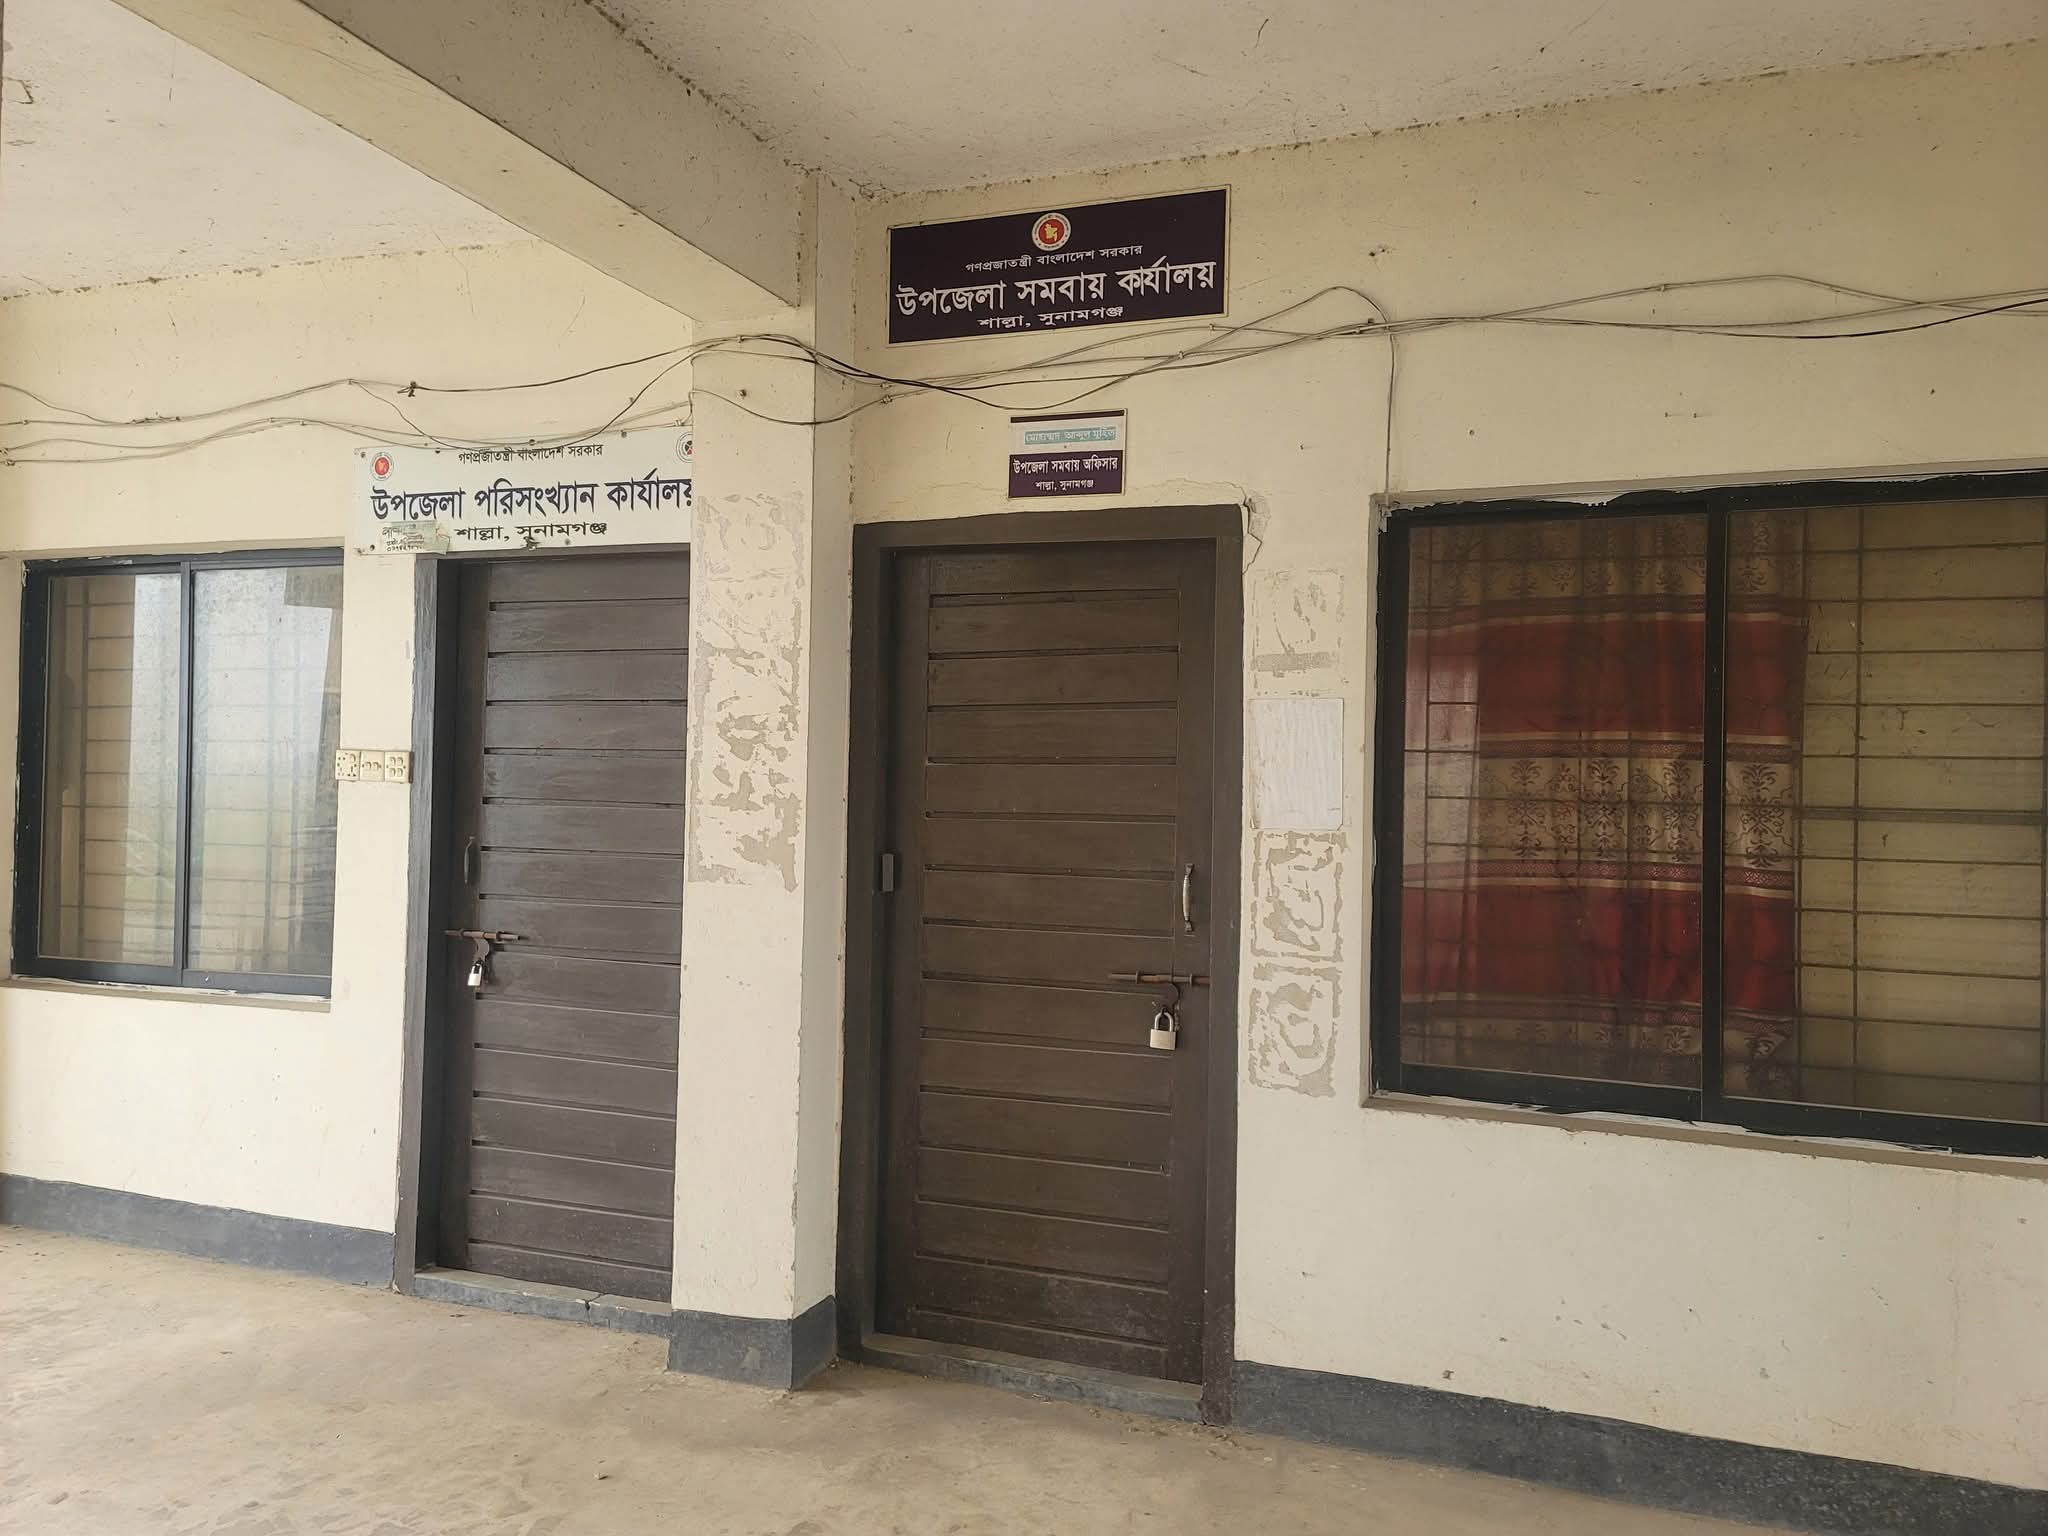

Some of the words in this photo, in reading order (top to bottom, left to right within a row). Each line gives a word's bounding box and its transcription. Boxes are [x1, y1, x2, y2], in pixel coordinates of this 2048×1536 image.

[965, 253, 1032, 272] গণপ্রজাতন্ত্রী
[1036, 250, 1094, 265] বাংলাদেশ
[1100, 245, 1143, 259] সরকার
[895, 280, 1007, 315] উপজেলা
[1014, 271, 1108, 306] সমবায়
[1115, 255, 1217, 296] কার্যালয়
[977, 314, 1032, 329] শাল্লা,
[1037, 306, 1124, 326] সুনামগঞ্জ
[517, 445, 565, 461] বাংলাদেশ
[568, 444, 604, 457] সরকার
[1013, 459, 1049, 474] উপজেলা
[1051, 459, 1080, 473] সমবায়
[1082, 454, 1119, 471] অফিসার
[1060, 479, 1094, 491] সুনামগঞ্জ
[370, 486, 467, 520] উপজেলা
[474, 477, 600, 518] পরিসংখ্যান
[454, 526, 510, 541] শাল্লা,
[514, 521, 608, 541] সুনামগঞ্জ
